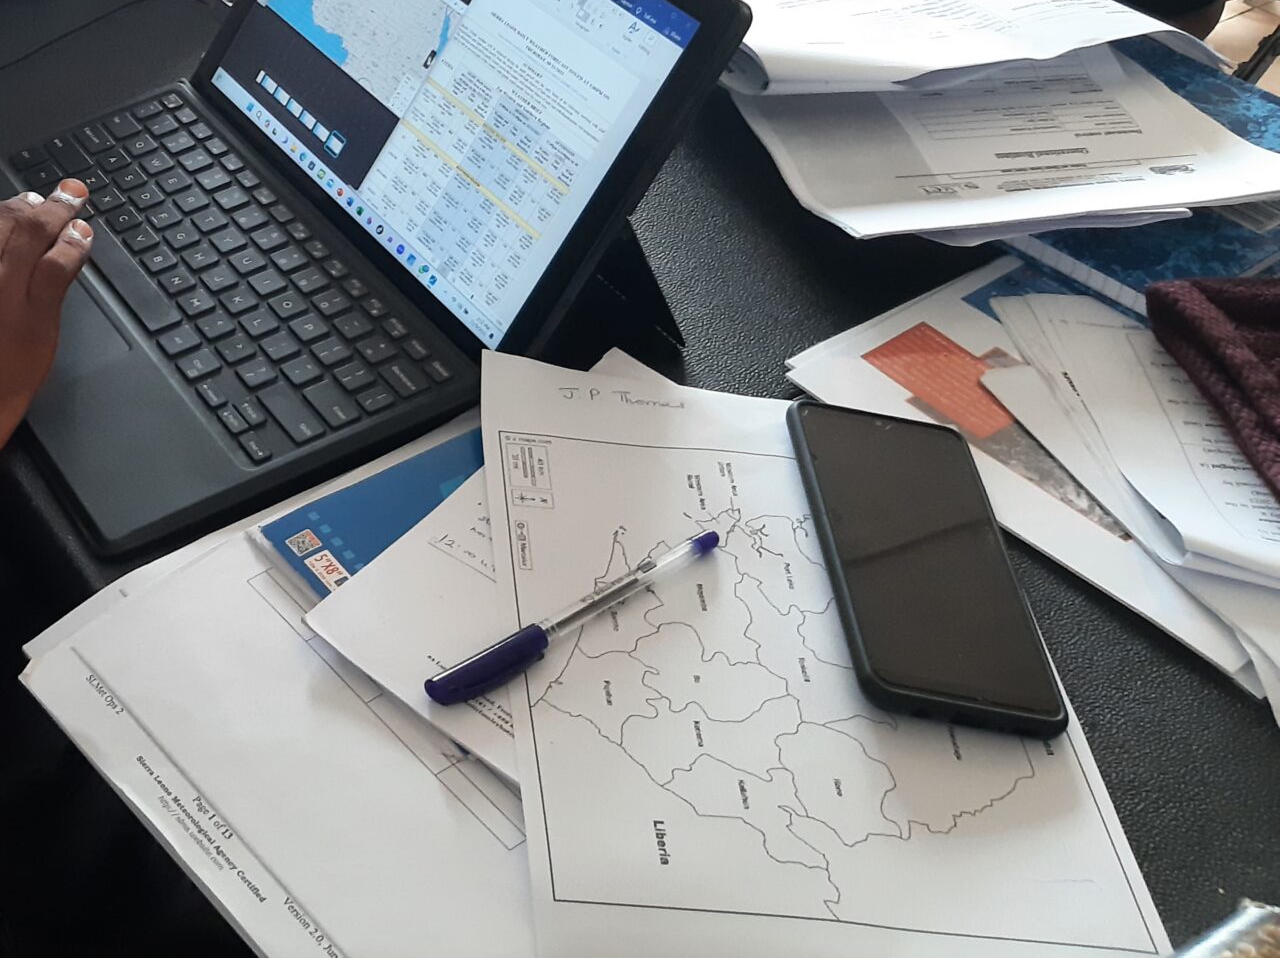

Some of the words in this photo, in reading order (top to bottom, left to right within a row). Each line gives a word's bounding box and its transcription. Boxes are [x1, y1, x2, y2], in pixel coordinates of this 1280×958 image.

[104, 694, 118, 711] Ops
[833, 778, 843, 798] Kono
[136, 755, 155, 776] Sierra
[153, 775, 173, 797] Leone
[171, 796, 216, 845] Meteorological
[213, 845, 238, 871] Agency
[236, 870, 268, 903] Certified
[192, 796, 210, 815] Page
[221, 828, 234, 840] 13
[653, 819, 670, 866] Liberia
[283, 897, 311, 930] Version
[308, 928, 325, 946] 2.0,
